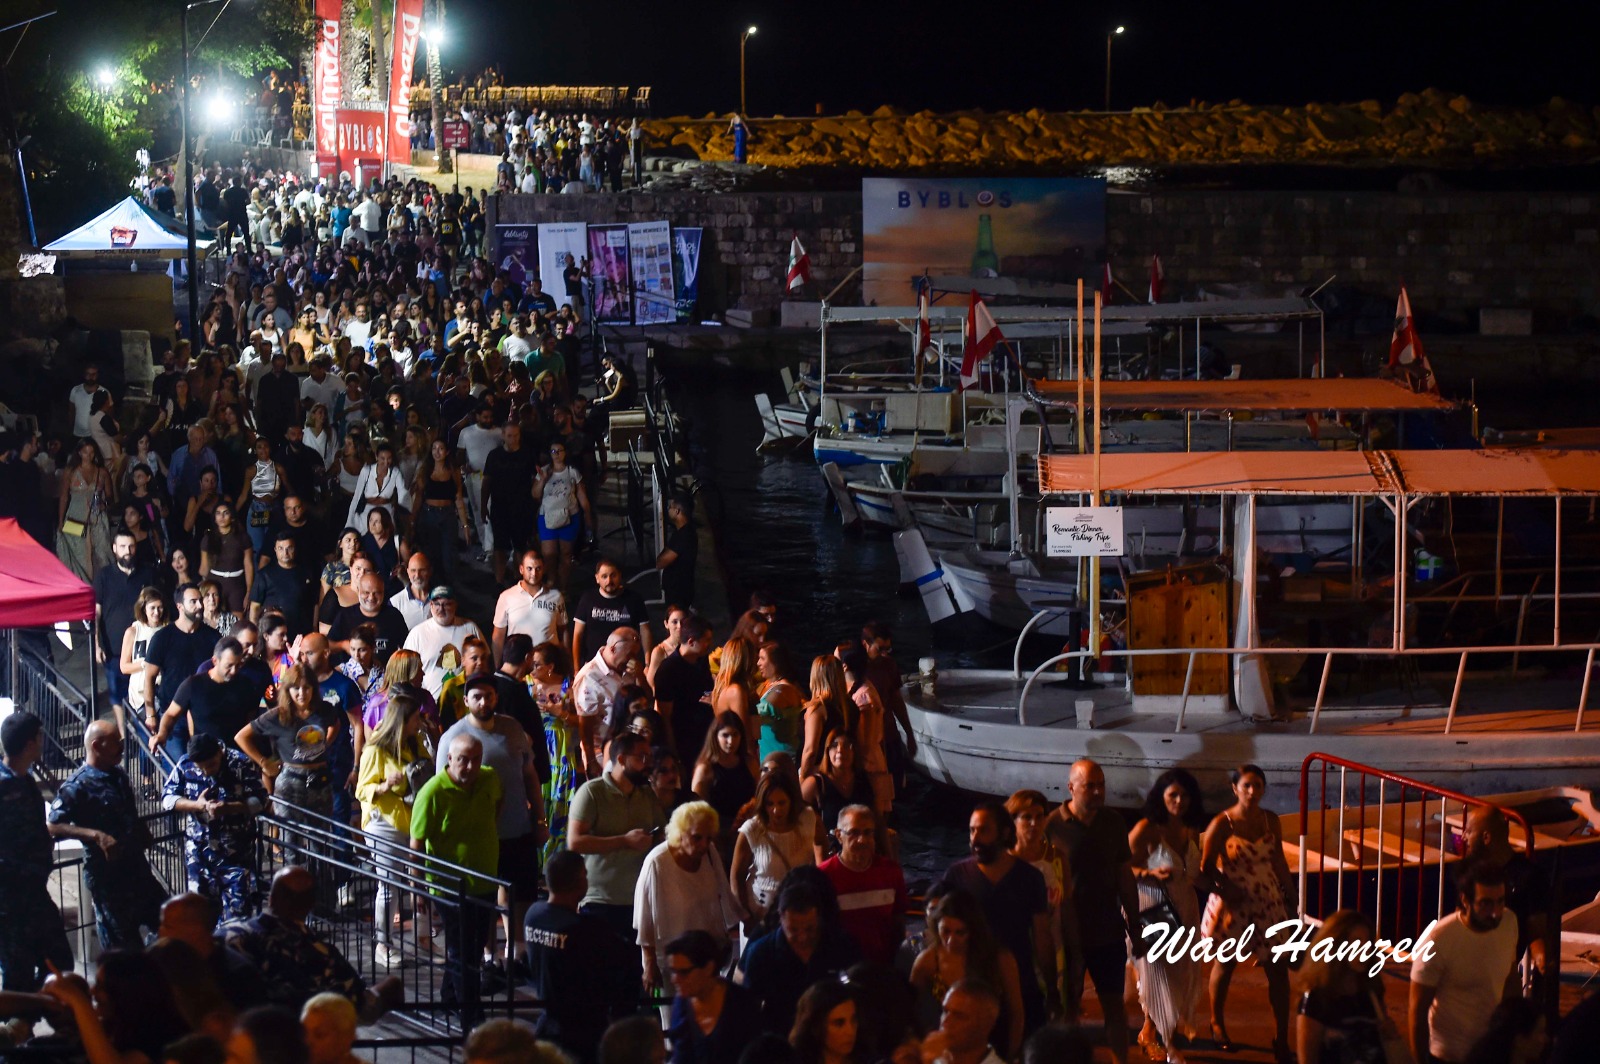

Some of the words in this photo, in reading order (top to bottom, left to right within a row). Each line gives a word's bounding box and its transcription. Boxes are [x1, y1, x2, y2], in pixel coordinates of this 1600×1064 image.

[317, 19, 340, 137] almaza
[391, 12, 421, 138] almaza
[1052, 524, 1080, 535] Romantic
[1081, 524, 1102, 532] Dinner
[1071, 533, 1093, 542] Fishing
[1095, 532, 1110, 542] Trips
[525, 926, 568, 949] SECURITY
